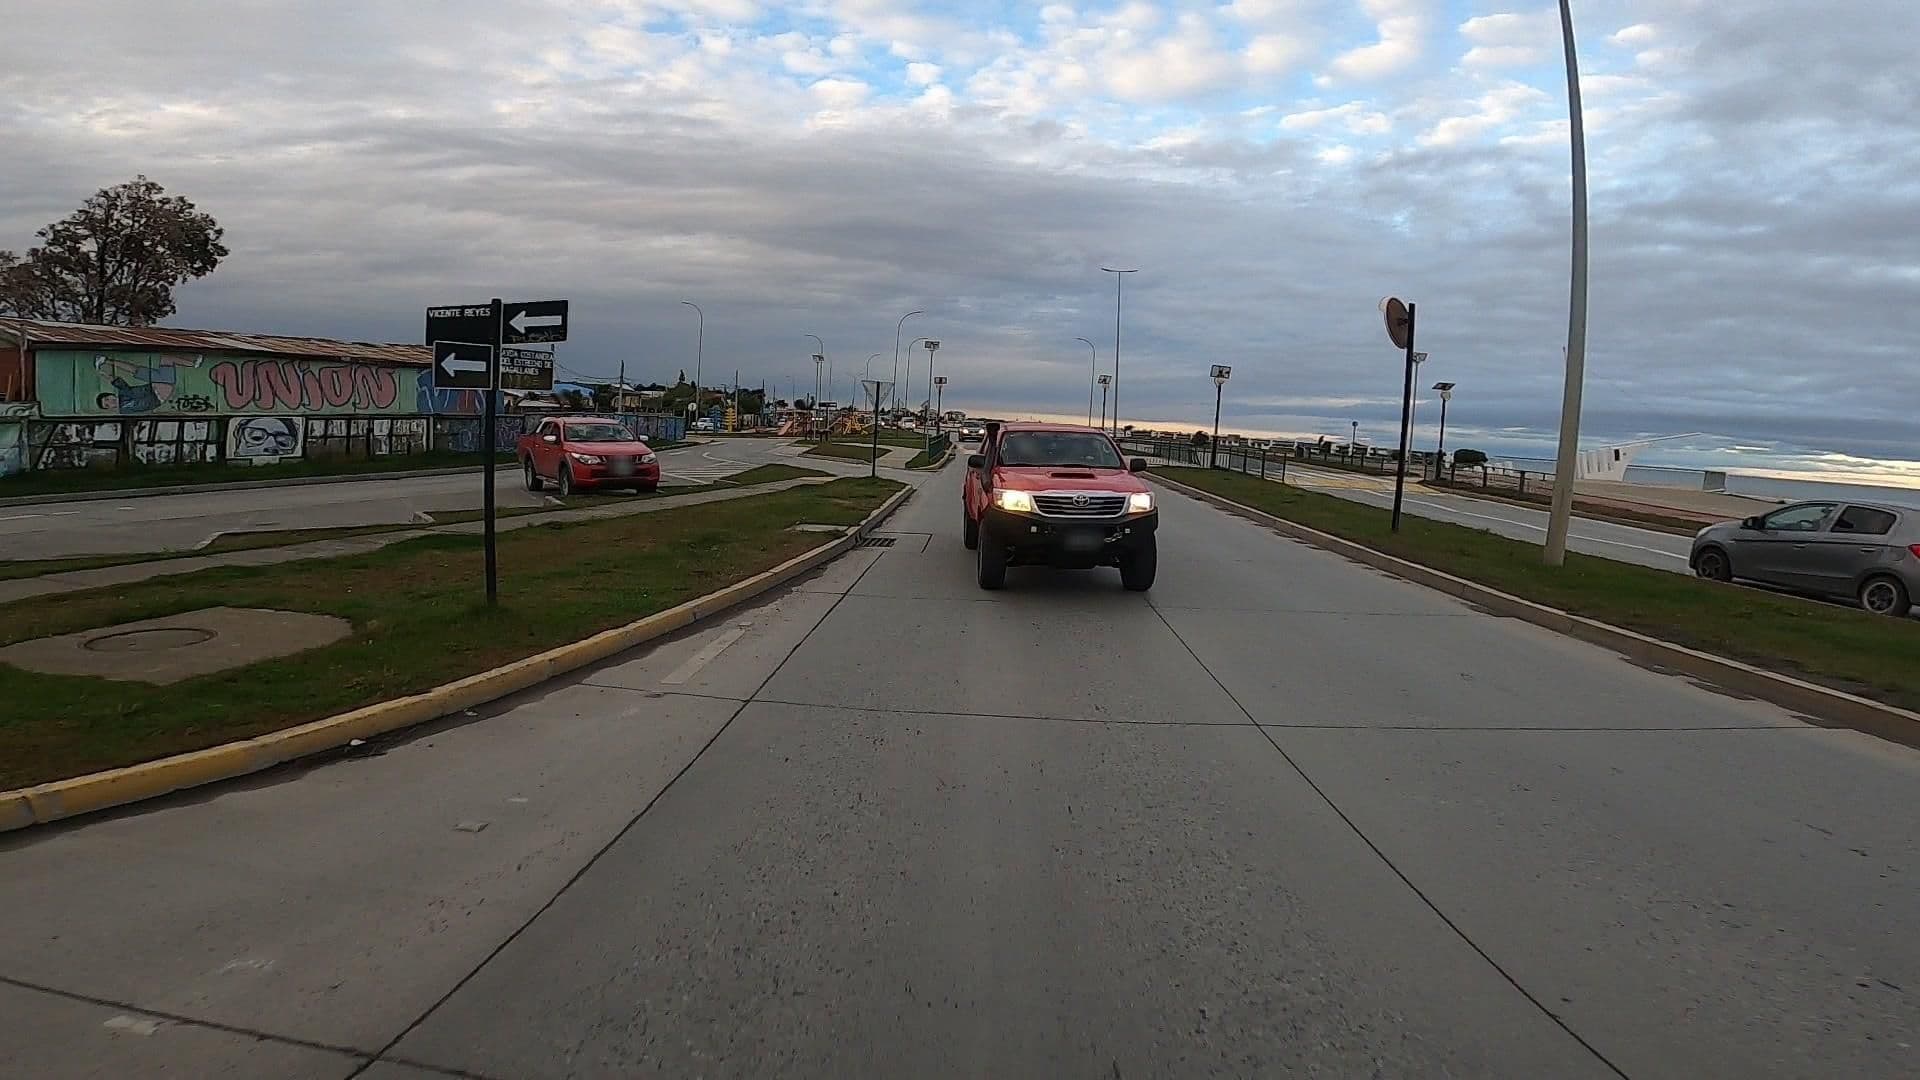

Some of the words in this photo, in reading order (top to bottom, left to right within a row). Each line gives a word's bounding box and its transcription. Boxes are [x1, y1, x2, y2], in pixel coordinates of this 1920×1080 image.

[429, 309, 461, 318] VICENTE
[464, 308, 491, 317] REYES
[521, 352, 553, 361] COSTANERA
[514, 359, 543, 368] ESTRECHO
[544, 361, 553, 369] DE
